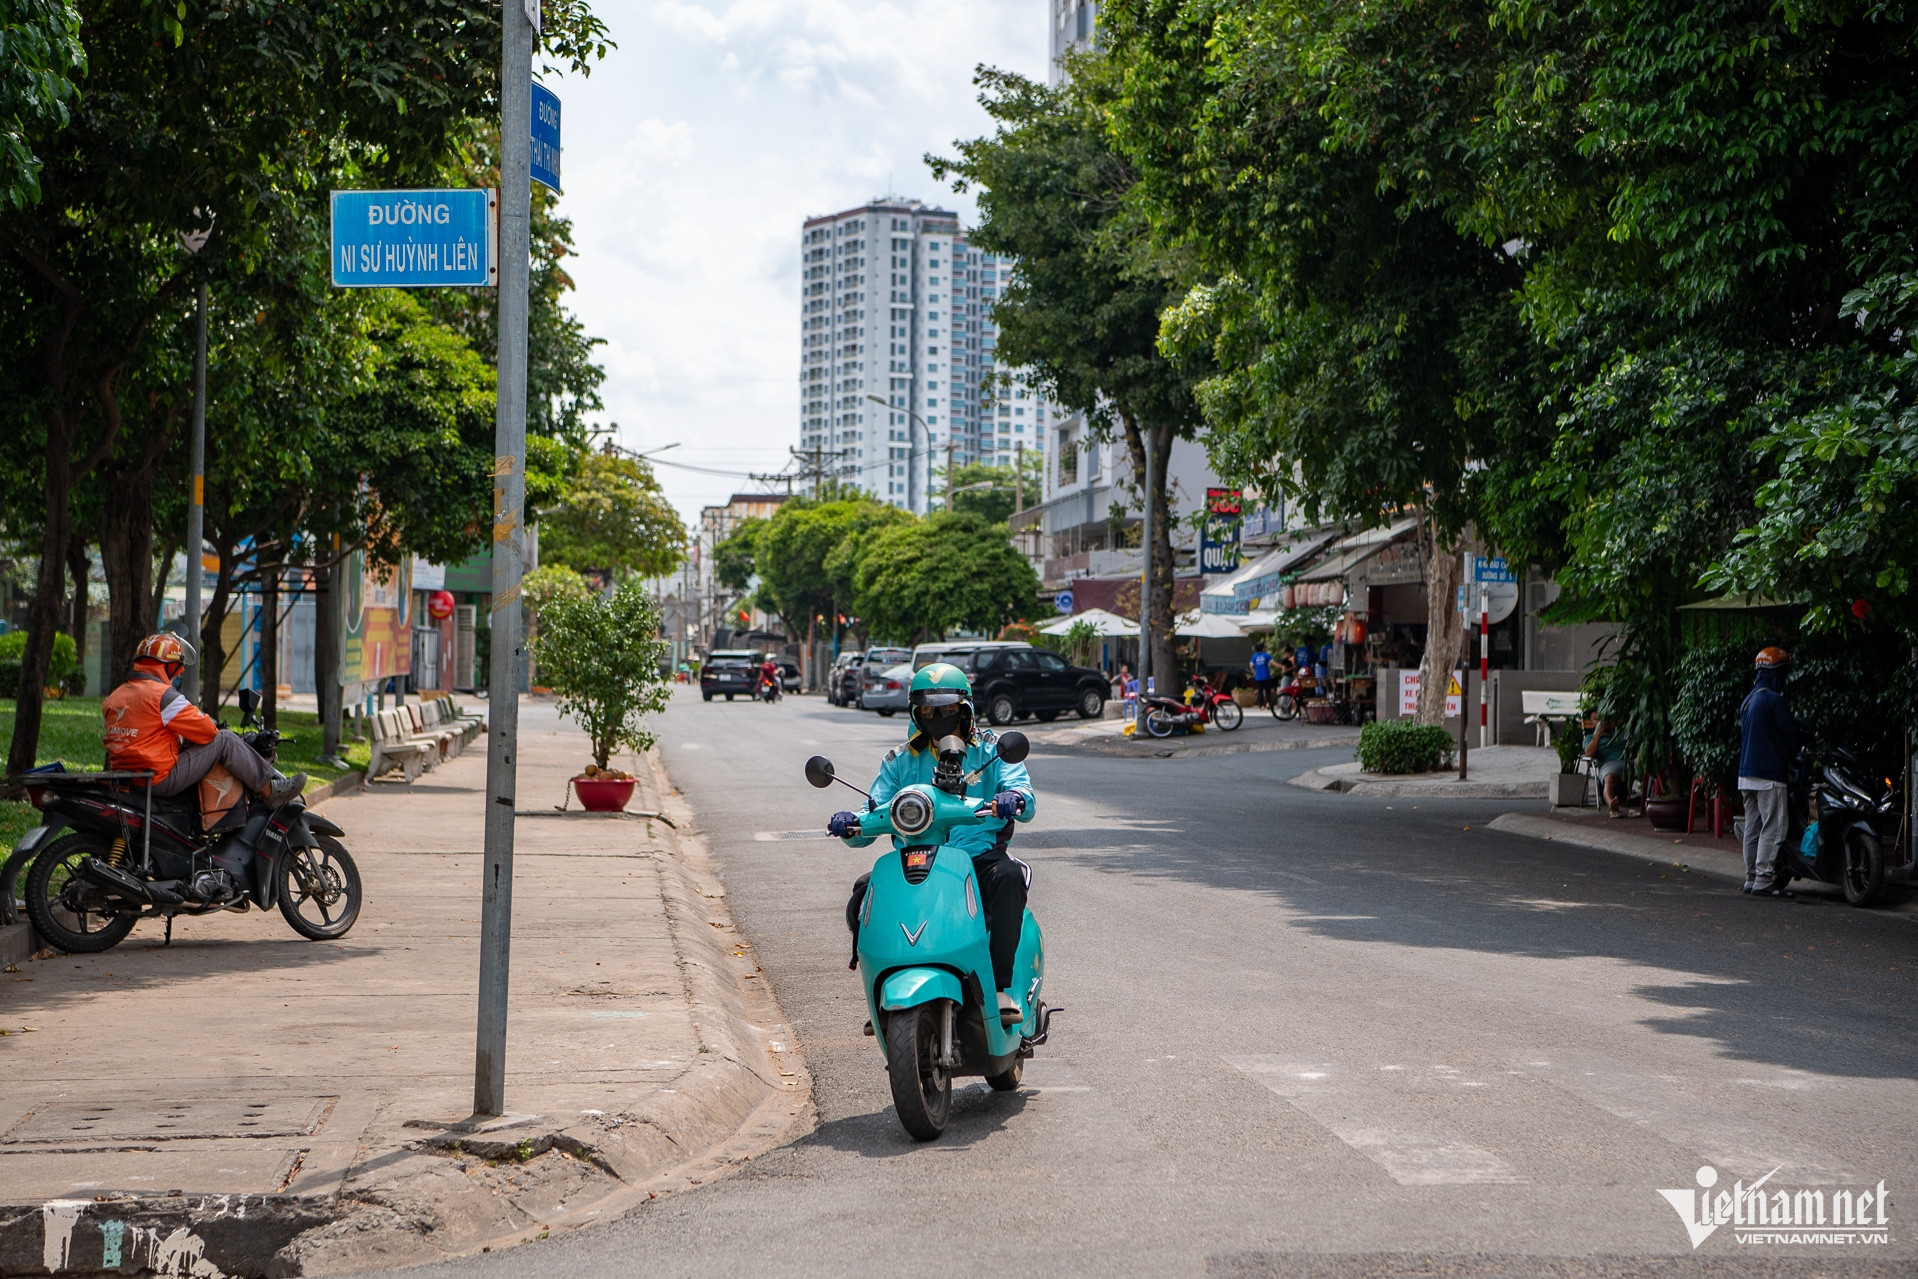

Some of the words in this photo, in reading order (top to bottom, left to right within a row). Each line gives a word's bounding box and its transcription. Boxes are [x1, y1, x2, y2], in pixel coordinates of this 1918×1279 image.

[368, 199, 450, 225] ĐƯỜNG
[341, 244, 356, 273] NI
[360, 240, 382, 273] SƯ
[385, 236, 438, 273] HUỲNH
[443, 235, 478, 271] LIÊN
